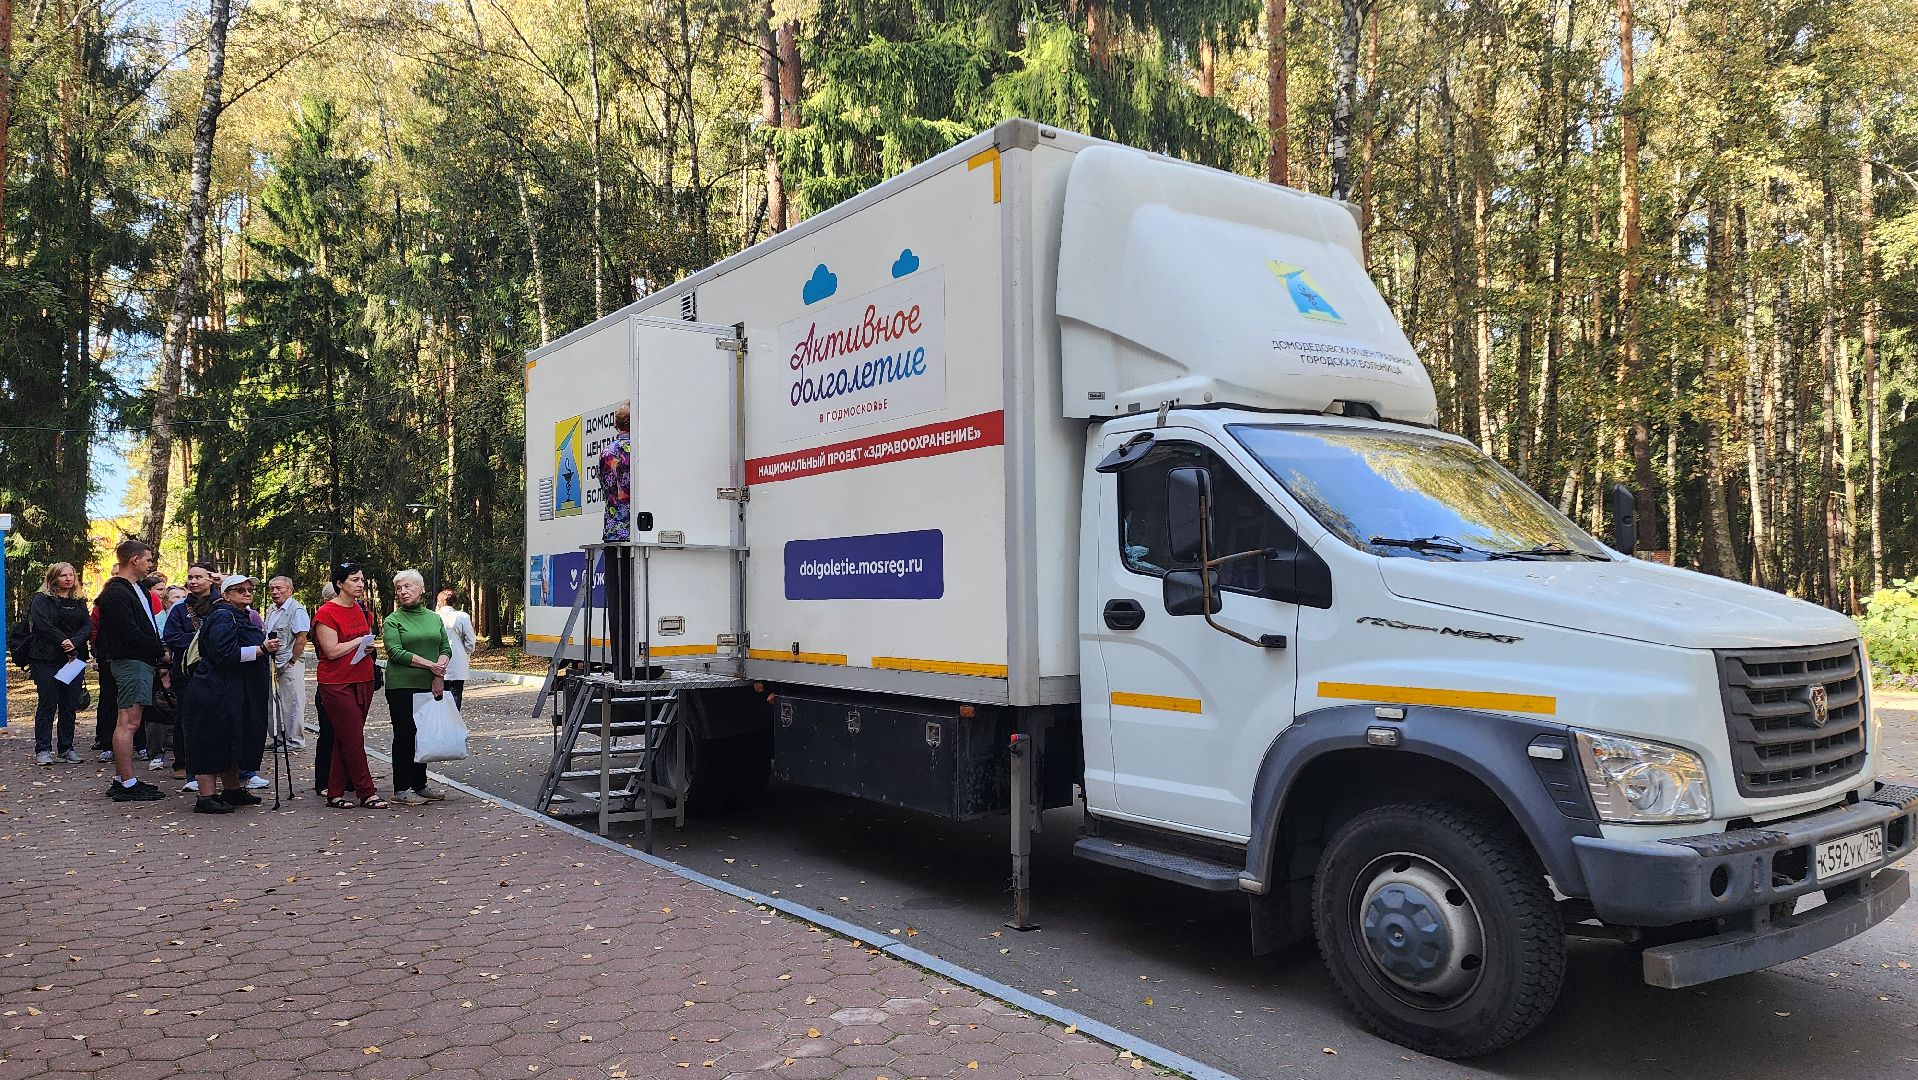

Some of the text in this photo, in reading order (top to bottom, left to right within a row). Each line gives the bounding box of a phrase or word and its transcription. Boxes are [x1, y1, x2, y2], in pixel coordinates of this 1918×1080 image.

[789, 304, 923, 370] Активное
[1272, 340, 1358, 356] ДОМОДЕДОВСКАЯ
[1299, 354, 1403, 375] ГОРОДСКАЯ БОЛЬНИЦА
[586, 411, 616, 436] ДОМОД
[758, 426, 982, 478] НАЦИОНАЛЬНЫЙ ПРОЕКТ «ЗДРАВООХРАНЕНИЕ»
[799, 557, 923, 580] dolgoletie.mosreg.ru
[1440, 626, 1524, 645] NEXT
[1863, 831, 1880, 854] 750
